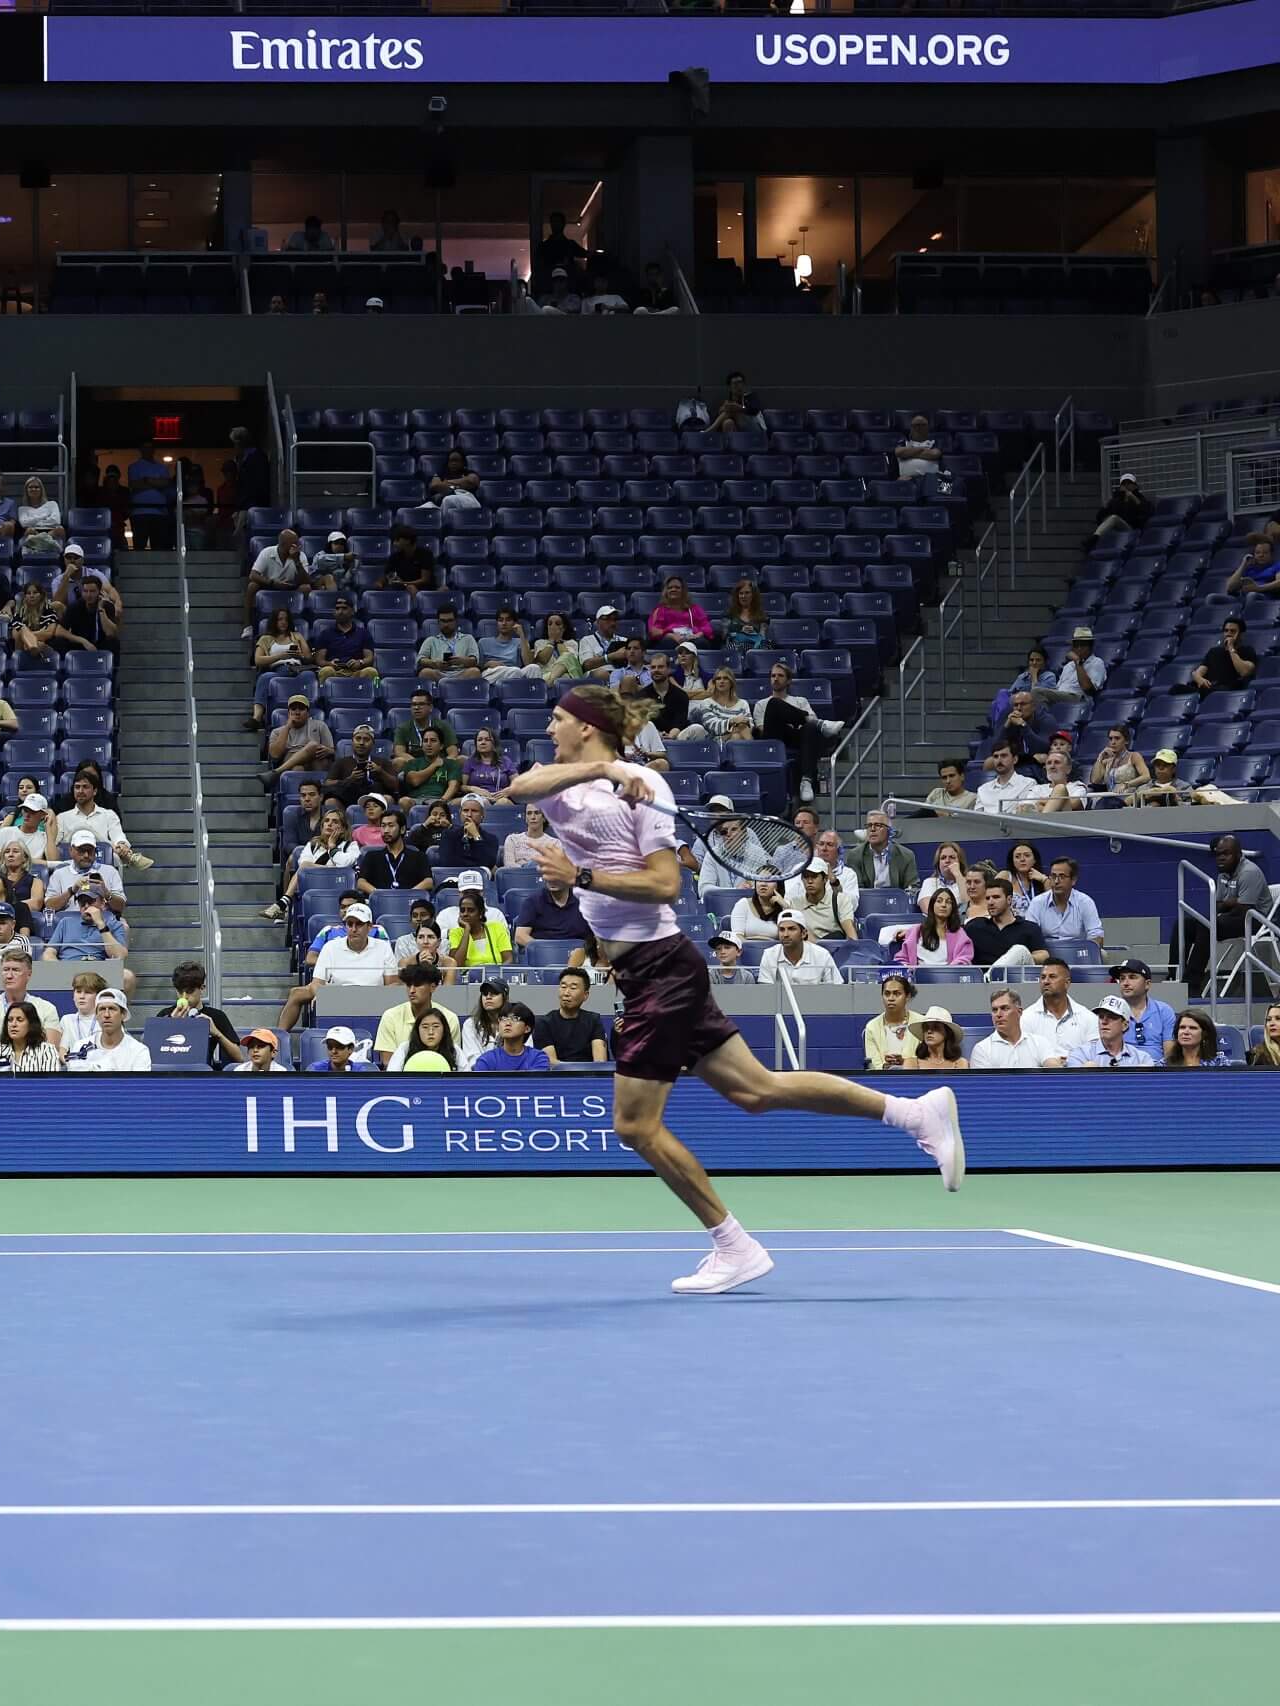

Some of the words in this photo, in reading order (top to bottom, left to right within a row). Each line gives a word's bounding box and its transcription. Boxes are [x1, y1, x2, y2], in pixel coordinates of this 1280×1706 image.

[231, 30, 424, 70] Emirates
[755, 33, 1010, 66] USOPEN.ORG
[443, 1095, 606, 1118] HOTELS
[445, 1129, 634, 1152] RESORT
